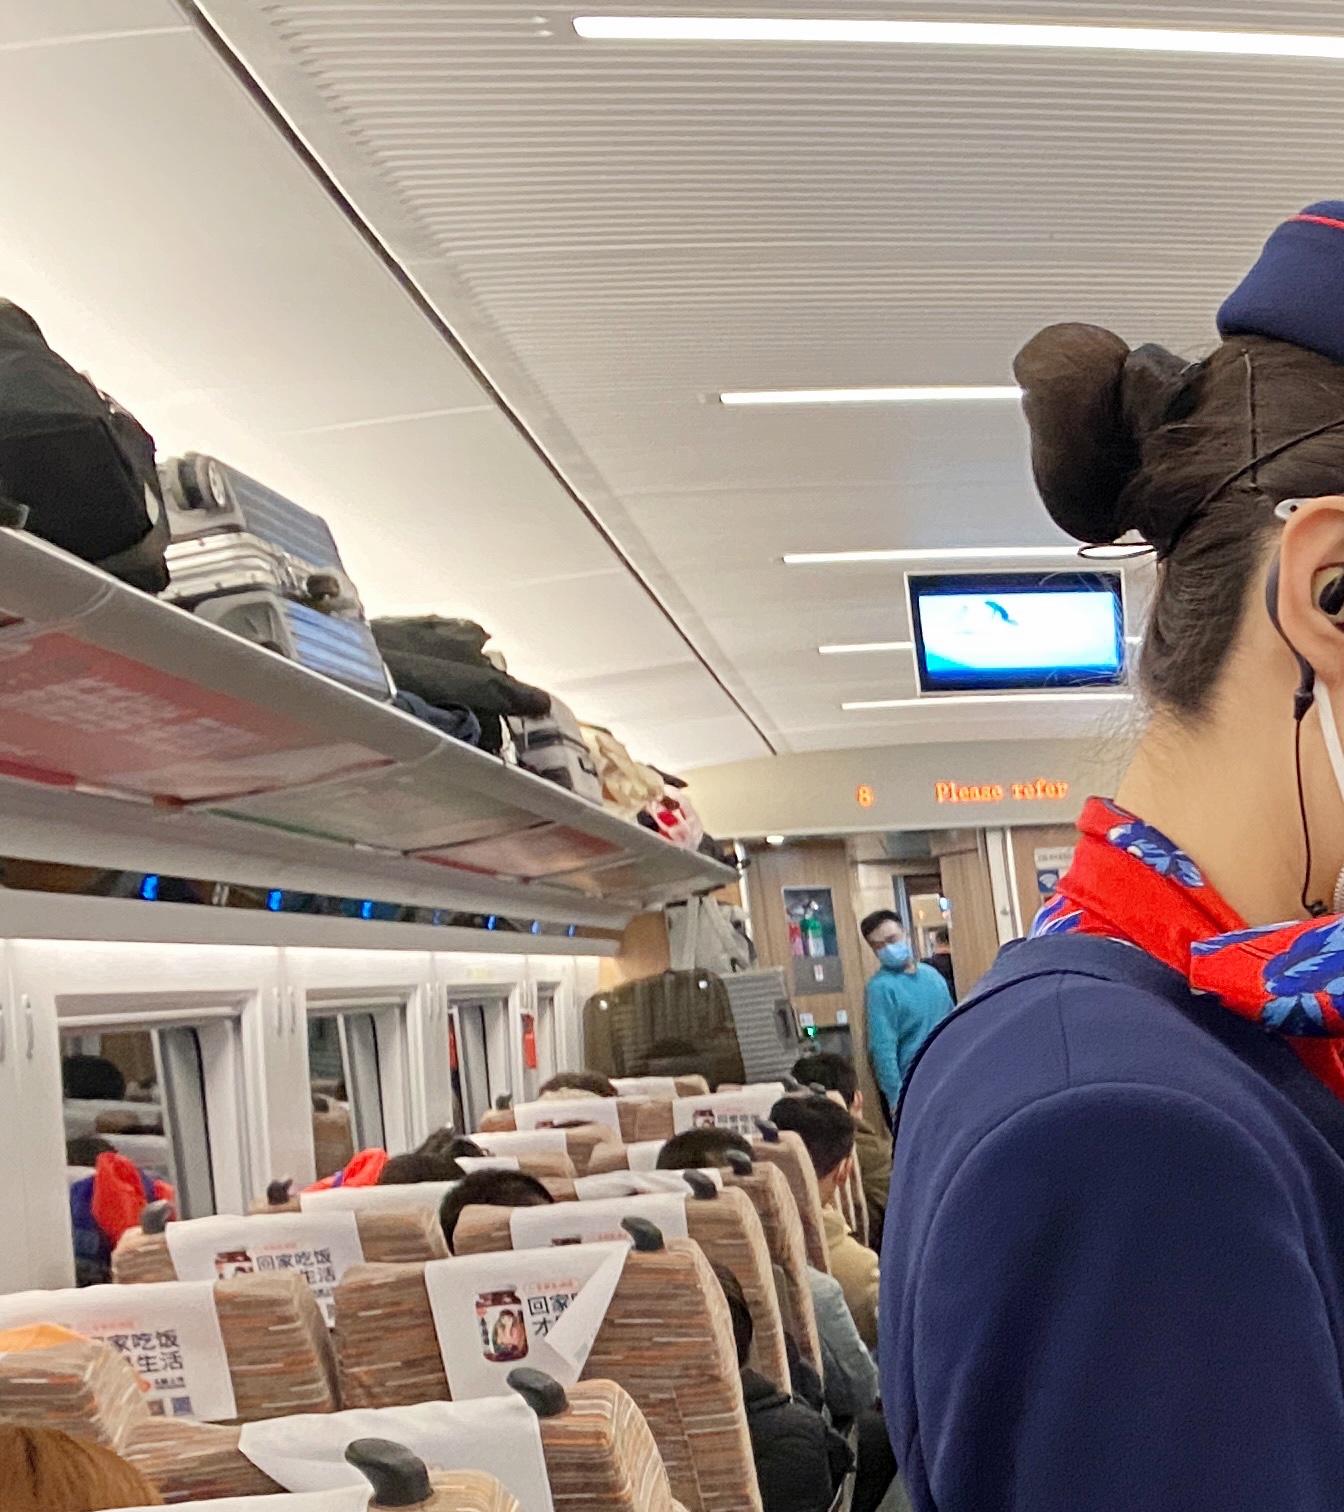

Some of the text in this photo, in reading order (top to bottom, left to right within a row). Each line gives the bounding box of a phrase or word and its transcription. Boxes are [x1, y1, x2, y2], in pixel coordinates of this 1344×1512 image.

[934, 779, 1004, 803] Please
[1011, 777, 1068, 800] refer
[527, 1293, 578, 1316] 回家
[91, 1329, 179, 1353] 家吃饭
